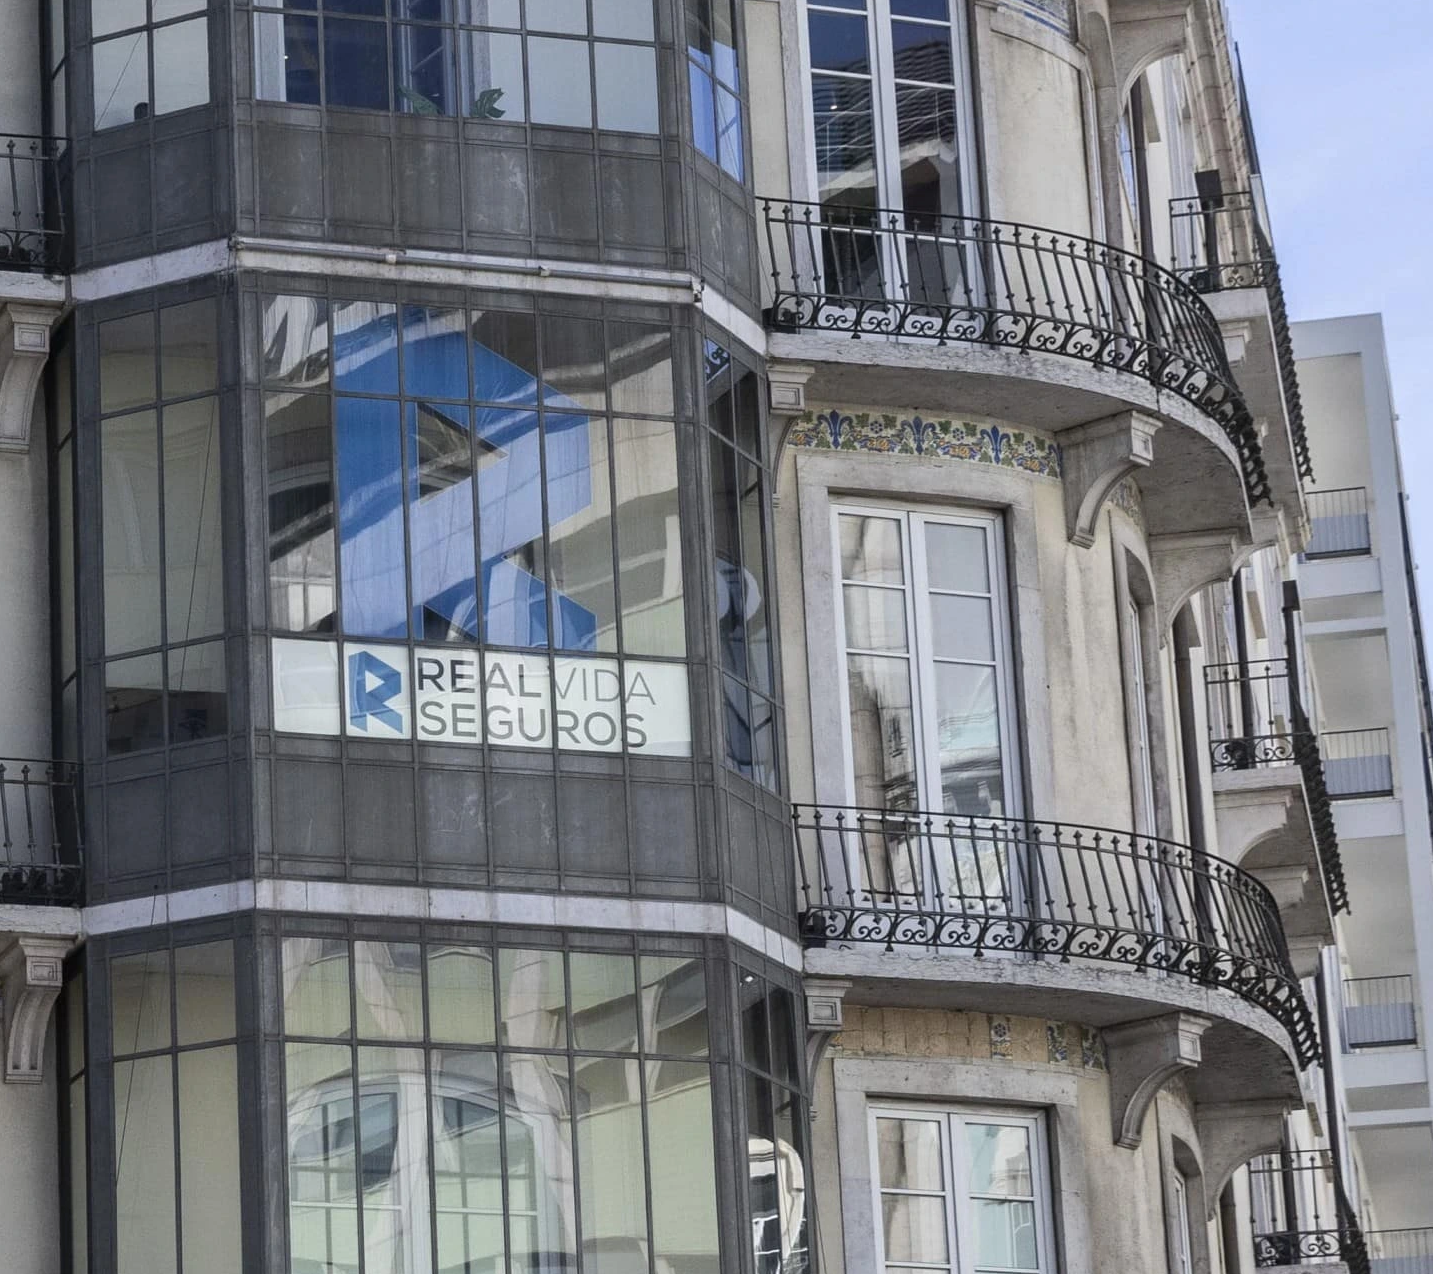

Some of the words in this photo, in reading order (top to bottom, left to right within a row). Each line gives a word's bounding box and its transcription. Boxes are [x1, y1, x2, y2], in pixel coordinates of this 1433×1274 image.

[417, 656, 542, 699] REAL
[554, 666, 656, 706] VIDA
[419, 700, 648, 748] SEGUROS
